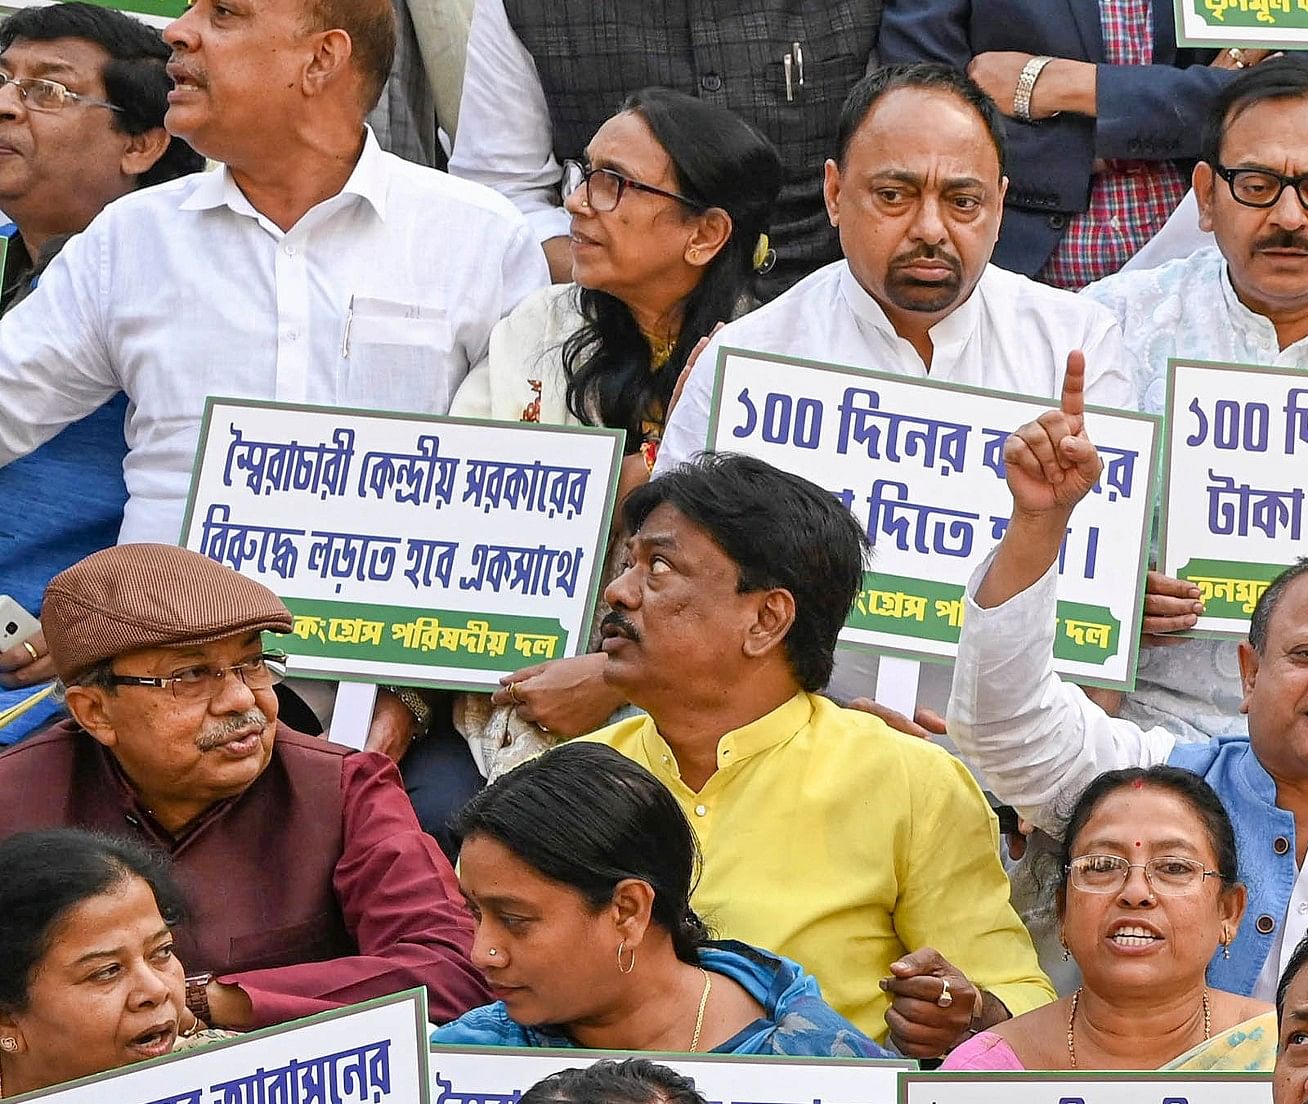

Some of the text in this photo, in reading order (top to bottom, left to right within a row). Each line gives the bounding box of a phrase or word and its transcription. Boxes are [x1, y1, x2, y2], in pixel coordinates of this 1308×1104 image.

[733, 388, 822, 451] ১০০
[836, 387, 970, 477] দিনের
[1186, 399, 1268, 453] ১০০
[222, 422, 590, 521] স্বৈরাচারী কেন্দ্রীয় সরকারের
[864, 479, 978, 559] দিতে
[1207, 475, 1303, 541] টাকা
[306, 530, 400, 595] লড়তে
[403, 538, 458, 590] হবে
[458, 543, 582, 599] একসাথে
[391, 616, 507, 656] পরিষদীয়
[514, 632, 557, 656] দল
[1064, 618, 1109, 647] দল
